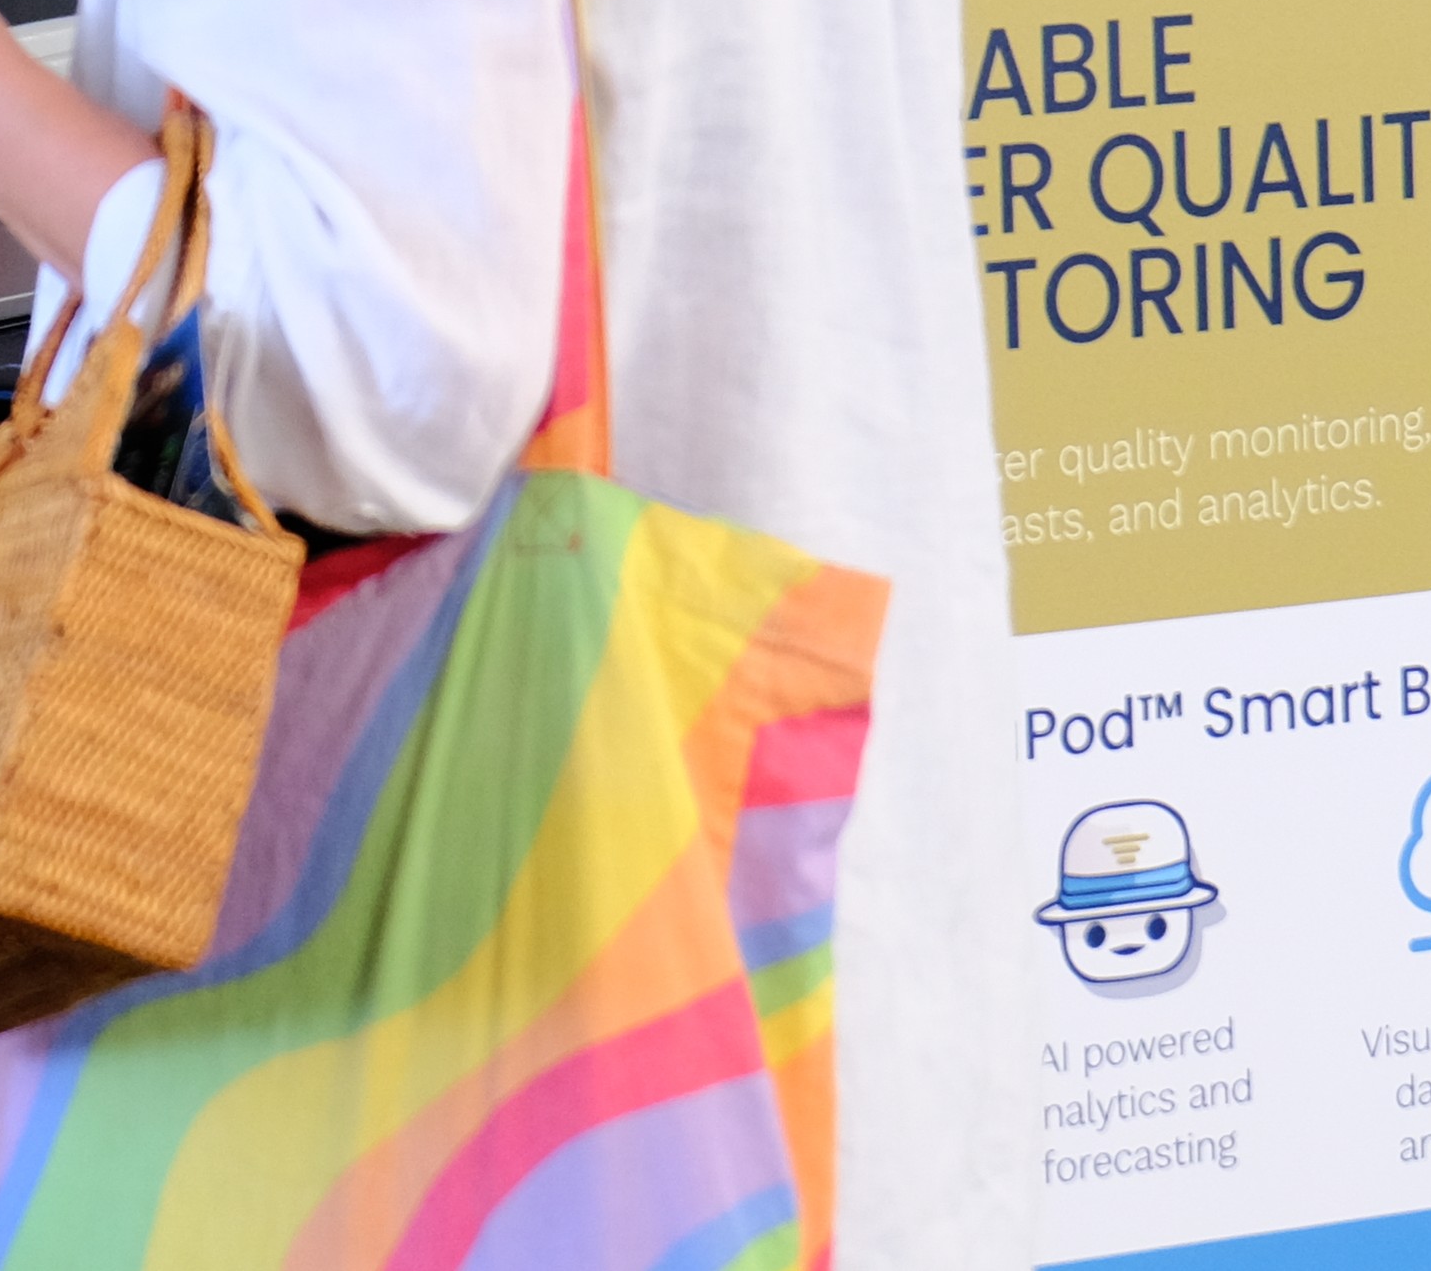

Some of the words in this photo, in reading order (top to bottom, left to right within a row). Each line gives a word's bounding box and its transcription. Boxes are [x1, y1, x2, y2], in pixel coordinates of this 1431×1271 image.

[968, 12, 1197, 122] ABLE
[986, 231, 1366, 350] TORING
[1059, 427, 1196, 485] quality
[1000, 504, 1095, 547] asts,
[1108, 487, 1183, 537] and
[1197, 473, 1383, 529] analytics.
[1203, 670, 1383, 739] Smart
[1041, 1041, 1068, 1073] AI
[1083, 1015, 1235, 1078] powered
[1043, 1085, 1176, 1132] nalytics
[1188, 1067, 1253, 1110] and
[1041, 1130, 1238, 1185] forecasting
